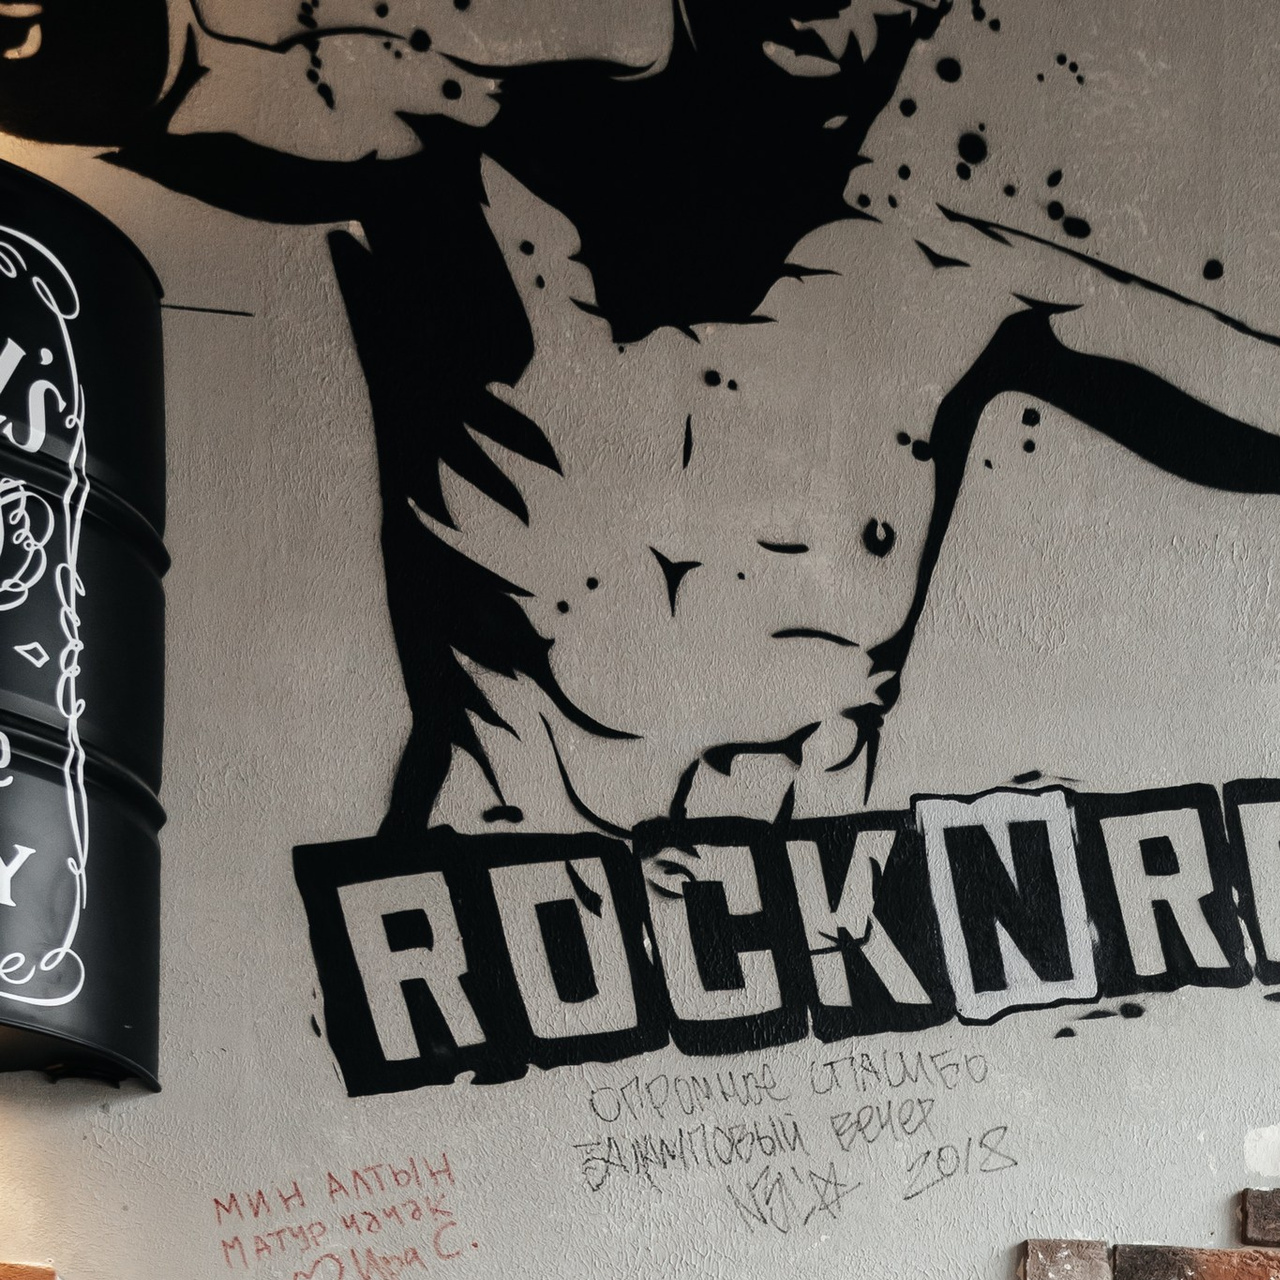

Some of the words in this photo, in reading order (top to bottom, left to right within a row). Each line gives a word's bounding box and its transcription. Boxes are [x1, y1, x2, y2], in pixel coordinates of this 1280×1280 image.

[213, 1180, 307, 1226] МИН
[327, 1152, 455, 1204] АЛТЫН
[903, 1125, 1019, 1201] 2018
